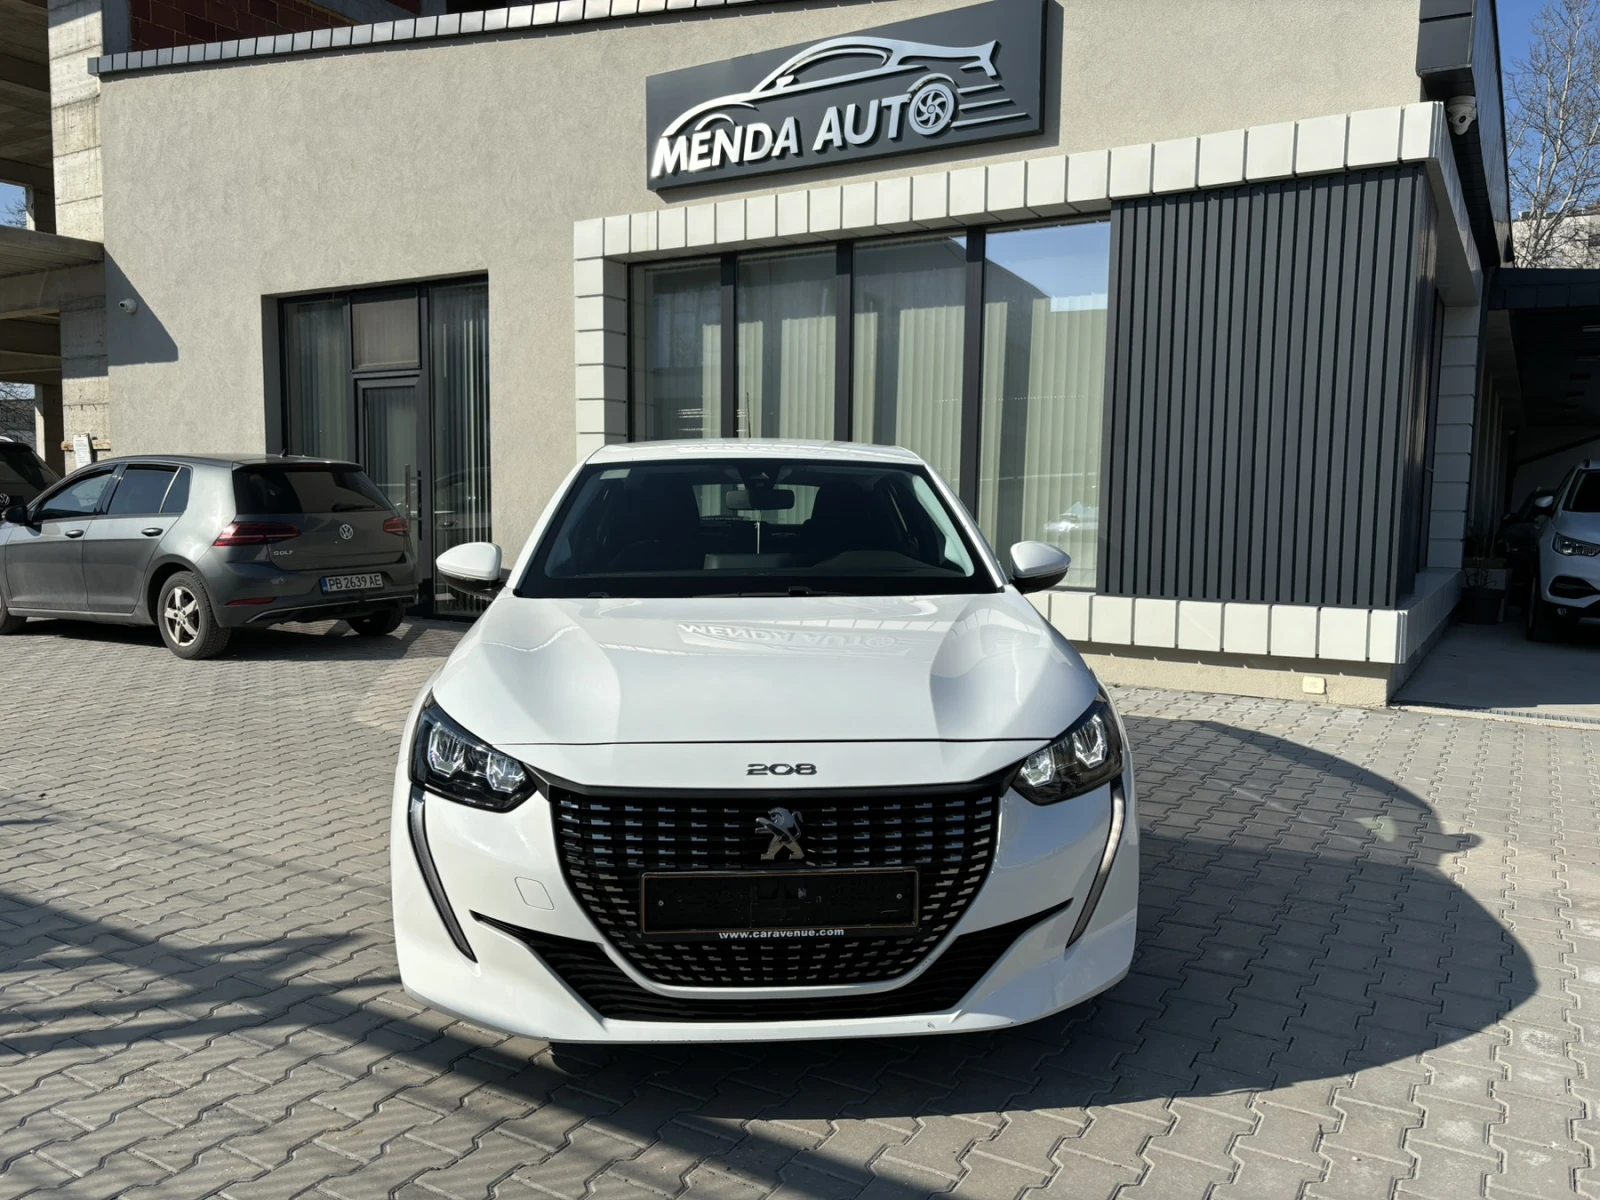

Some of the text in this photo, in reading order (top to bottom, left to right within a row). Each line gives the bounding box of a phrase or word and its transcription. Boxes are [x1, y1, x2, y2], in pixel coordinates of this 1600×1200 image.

[650, 83, 954, 178] MENDA AUTO
[328, 574, 381, 590] PB 2639 AE
[745, 763, 818, 776] 208
[719, 928, 845, 939] www.caravenue.com
